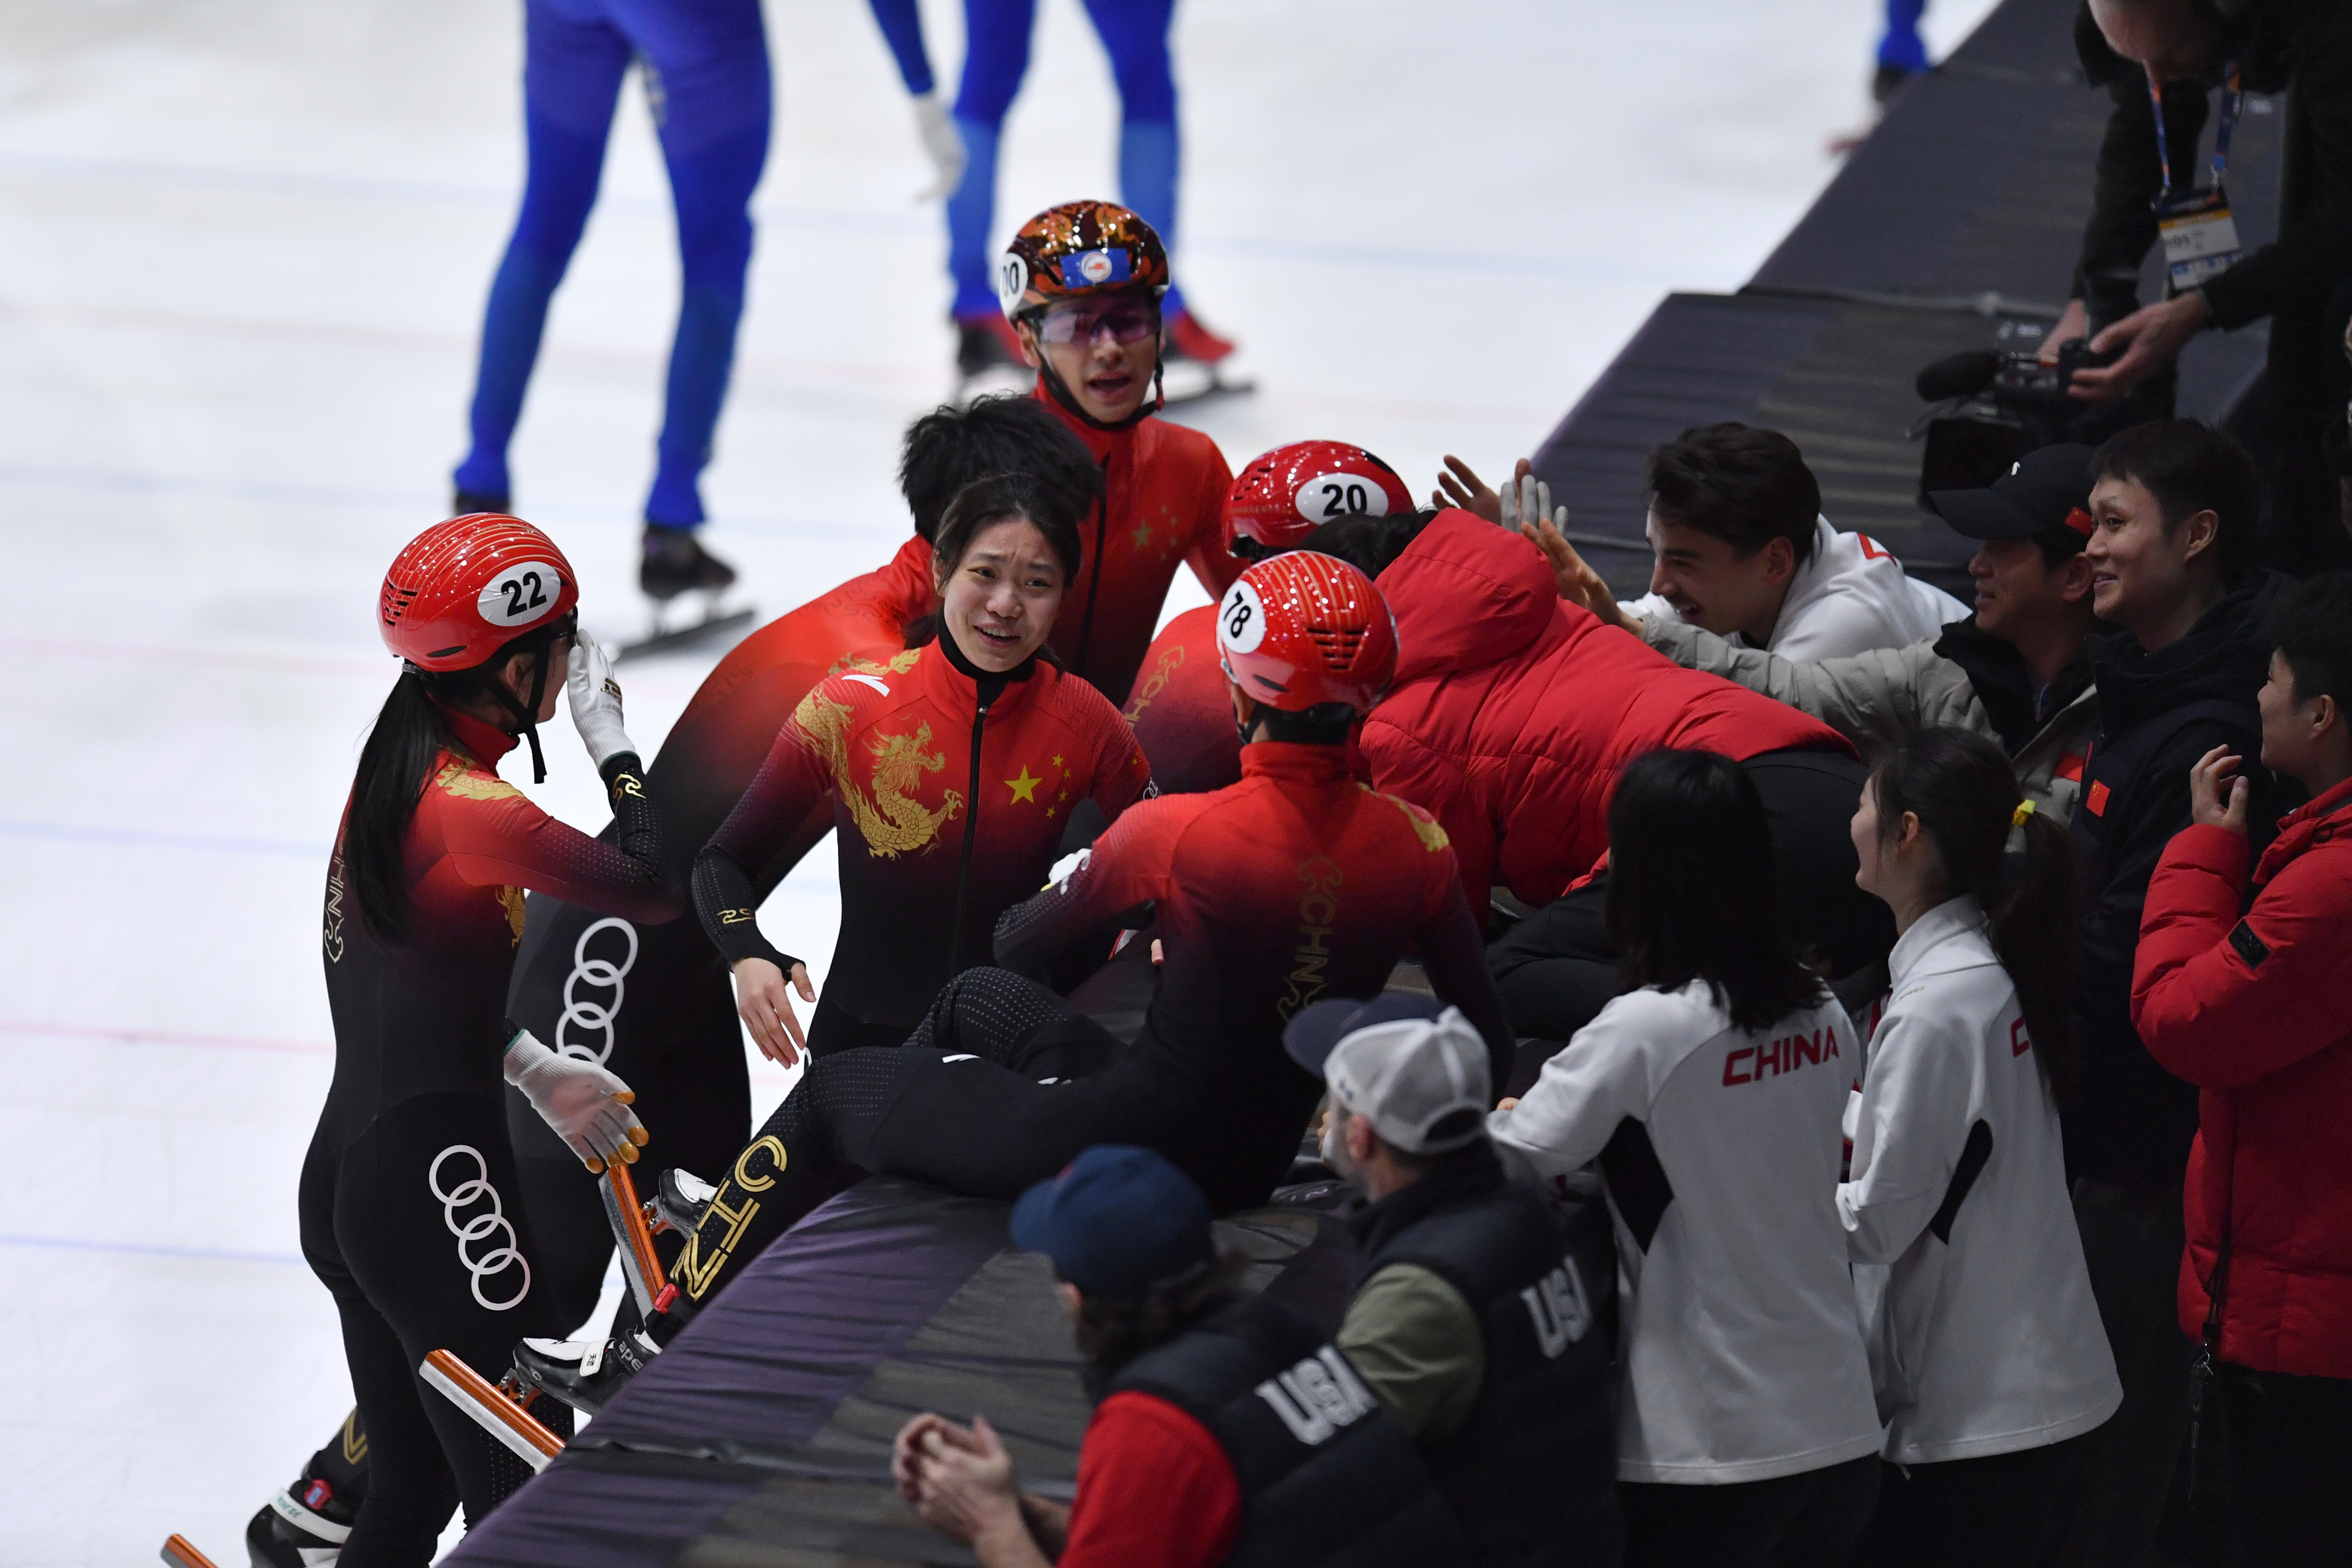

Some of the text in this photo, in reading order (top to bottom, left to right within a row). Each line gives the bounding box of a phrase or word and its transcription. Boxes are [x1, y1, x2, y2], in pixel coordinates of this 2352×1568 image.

[1322, 484, 1367, 517] 20
[501, 572, 547, 617] 22
[1223, 590, 1252, 639] 78
[1124, 674, 1164, 727] CH
[1722, 1026, 1839, 1087] CHINA
